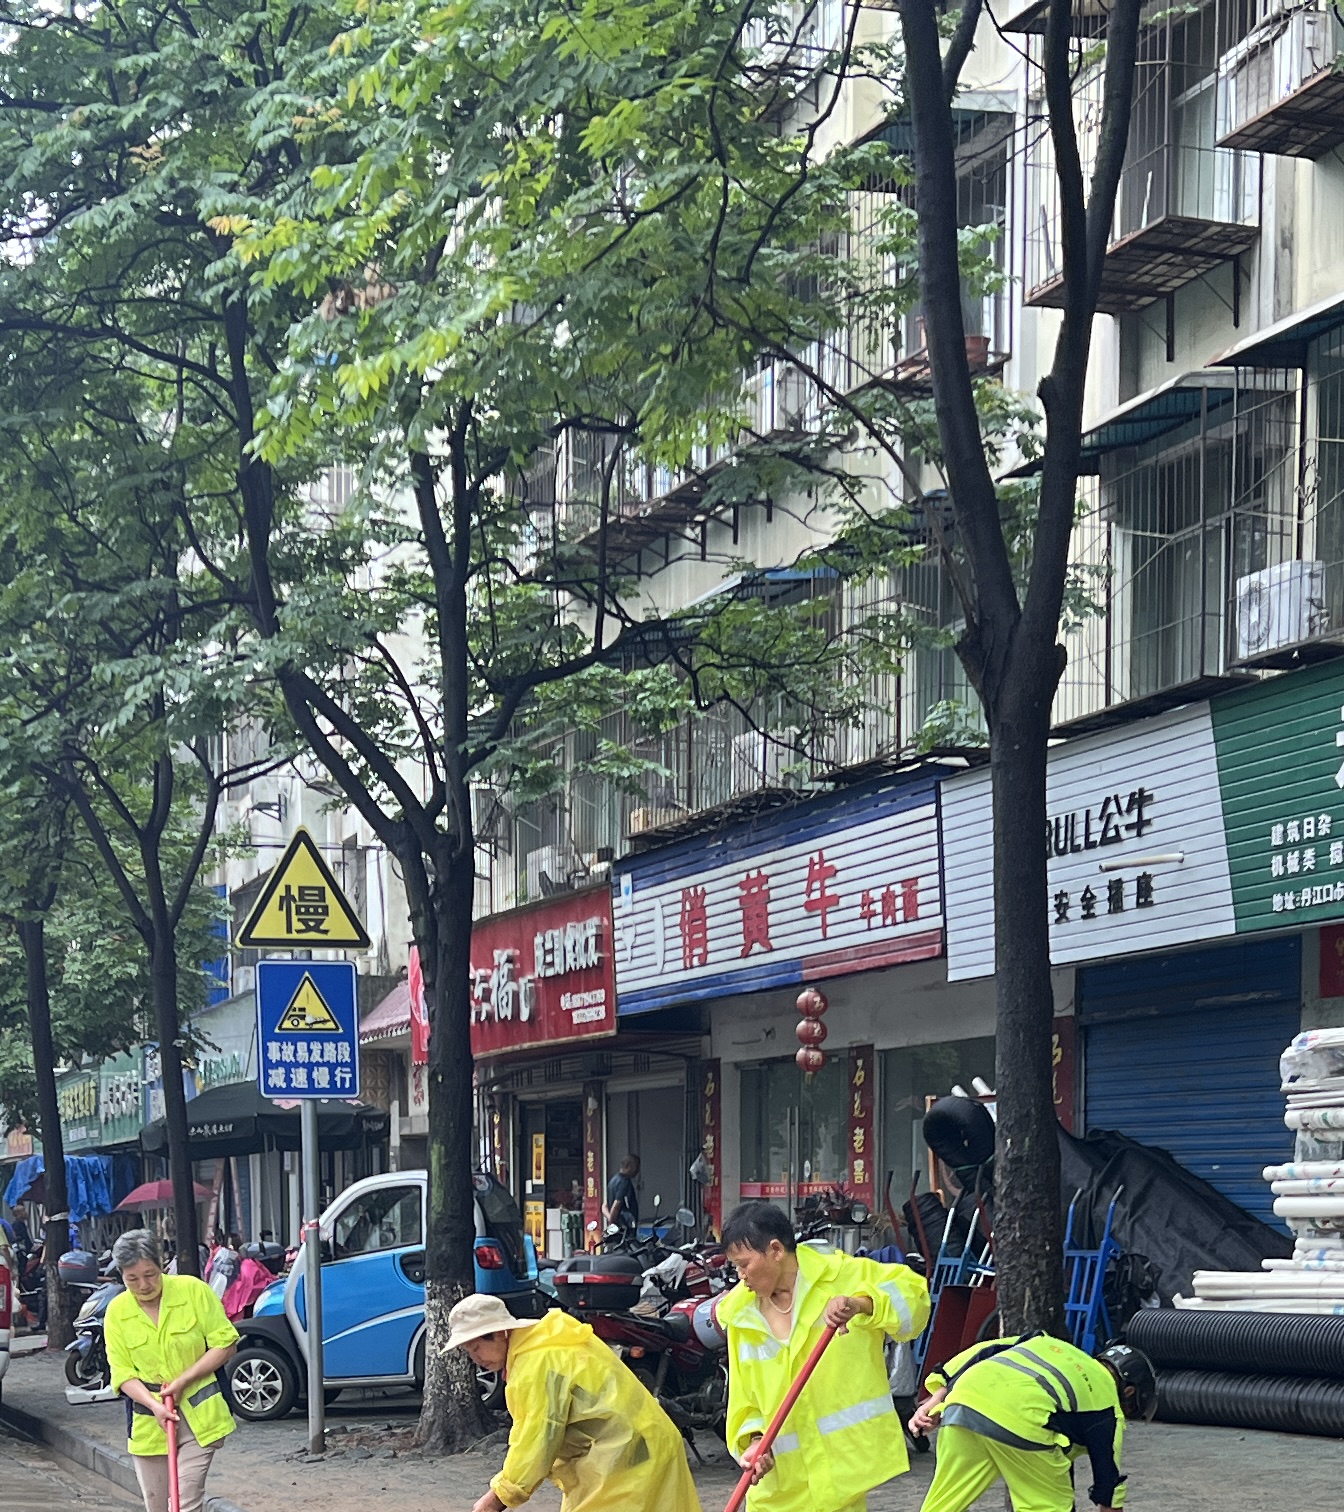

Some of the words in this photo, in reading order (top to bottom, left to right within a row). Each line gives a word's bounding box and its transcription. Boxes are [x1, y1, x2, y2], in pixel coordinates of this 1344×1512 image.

[1271, 813, 1333, 846] 建筑日杂
[1271, 848, 1317, 878] 机械类
[278, 884, 330, 934] 慢
[267, 1041, 352, 1064] 事故易发路段
[268, 1067, 353, 1089] 减速慢行
